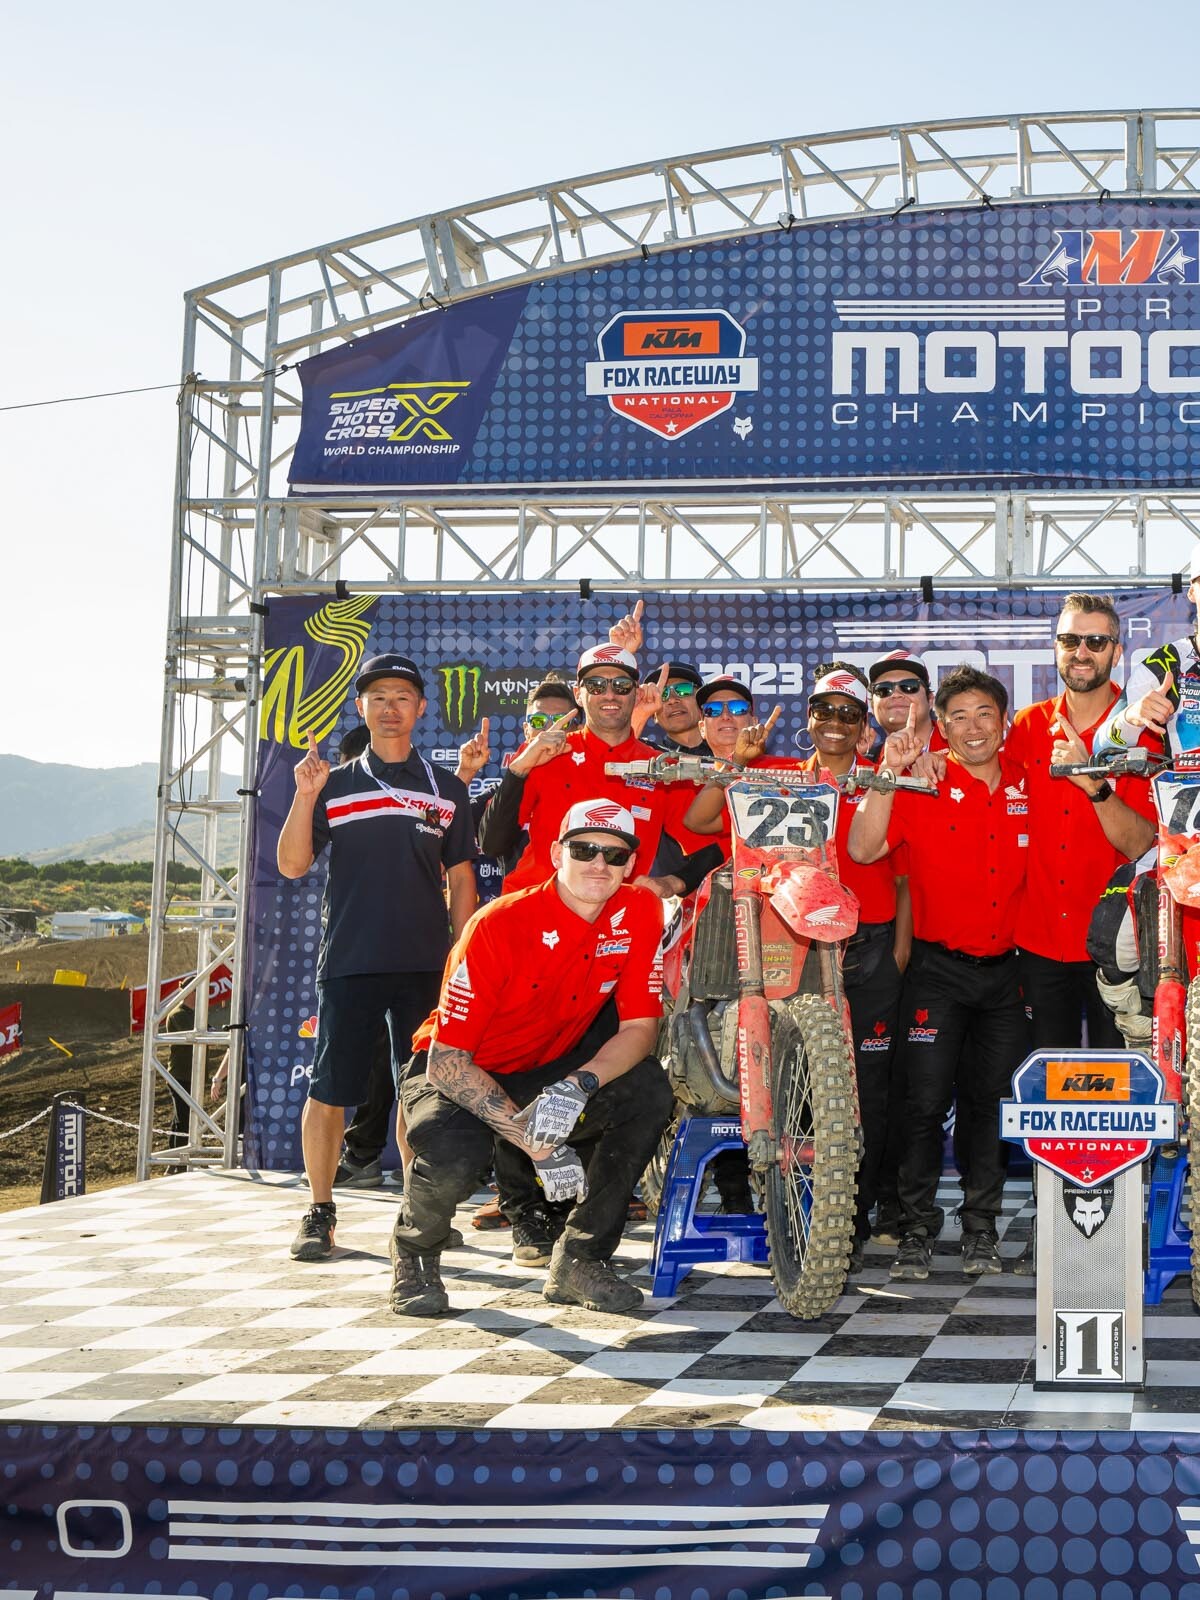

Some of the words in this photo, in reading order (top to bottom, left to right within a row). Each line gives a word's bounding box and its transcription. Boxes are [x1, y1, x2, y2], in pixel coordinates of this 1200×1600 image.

[1018, 228, 1200, 287] AMA
[641, 328, 702, 349] KTM
[603, 367, 641, 388] FOX
[644, 365, 741, 387] RACEWAY
[328, 398, 400, 416] SUPER
[624, 396, 719, 406] NATIONAL
[331, 411, 396, 428] MOTO
[324, 425, 396, 441] CROSS
[323, 446, 366, 457] WORLD
[367, 444, 461, 456] CHAMPIONSHIP
[825, 685, 856, 697] HONDA
[584, 820, 623, 831] HONDA
[744, 798, 831, 849] 23
[806, 920, 848, 928] HONDA
[738, 1027, 751, 1113] DUNLOP
[1061, 1073, 1114, 1092] KTM
[1019, 1110, 1057, 1131] FOX
[1064, 1110, 1157, 1133] RACEWAY
[1041, 1141, 1136, 1151] NATIONAL
[64, 1113, 77, 1199] MOTOC
[1076, 1315, 1103, 1376] 1
